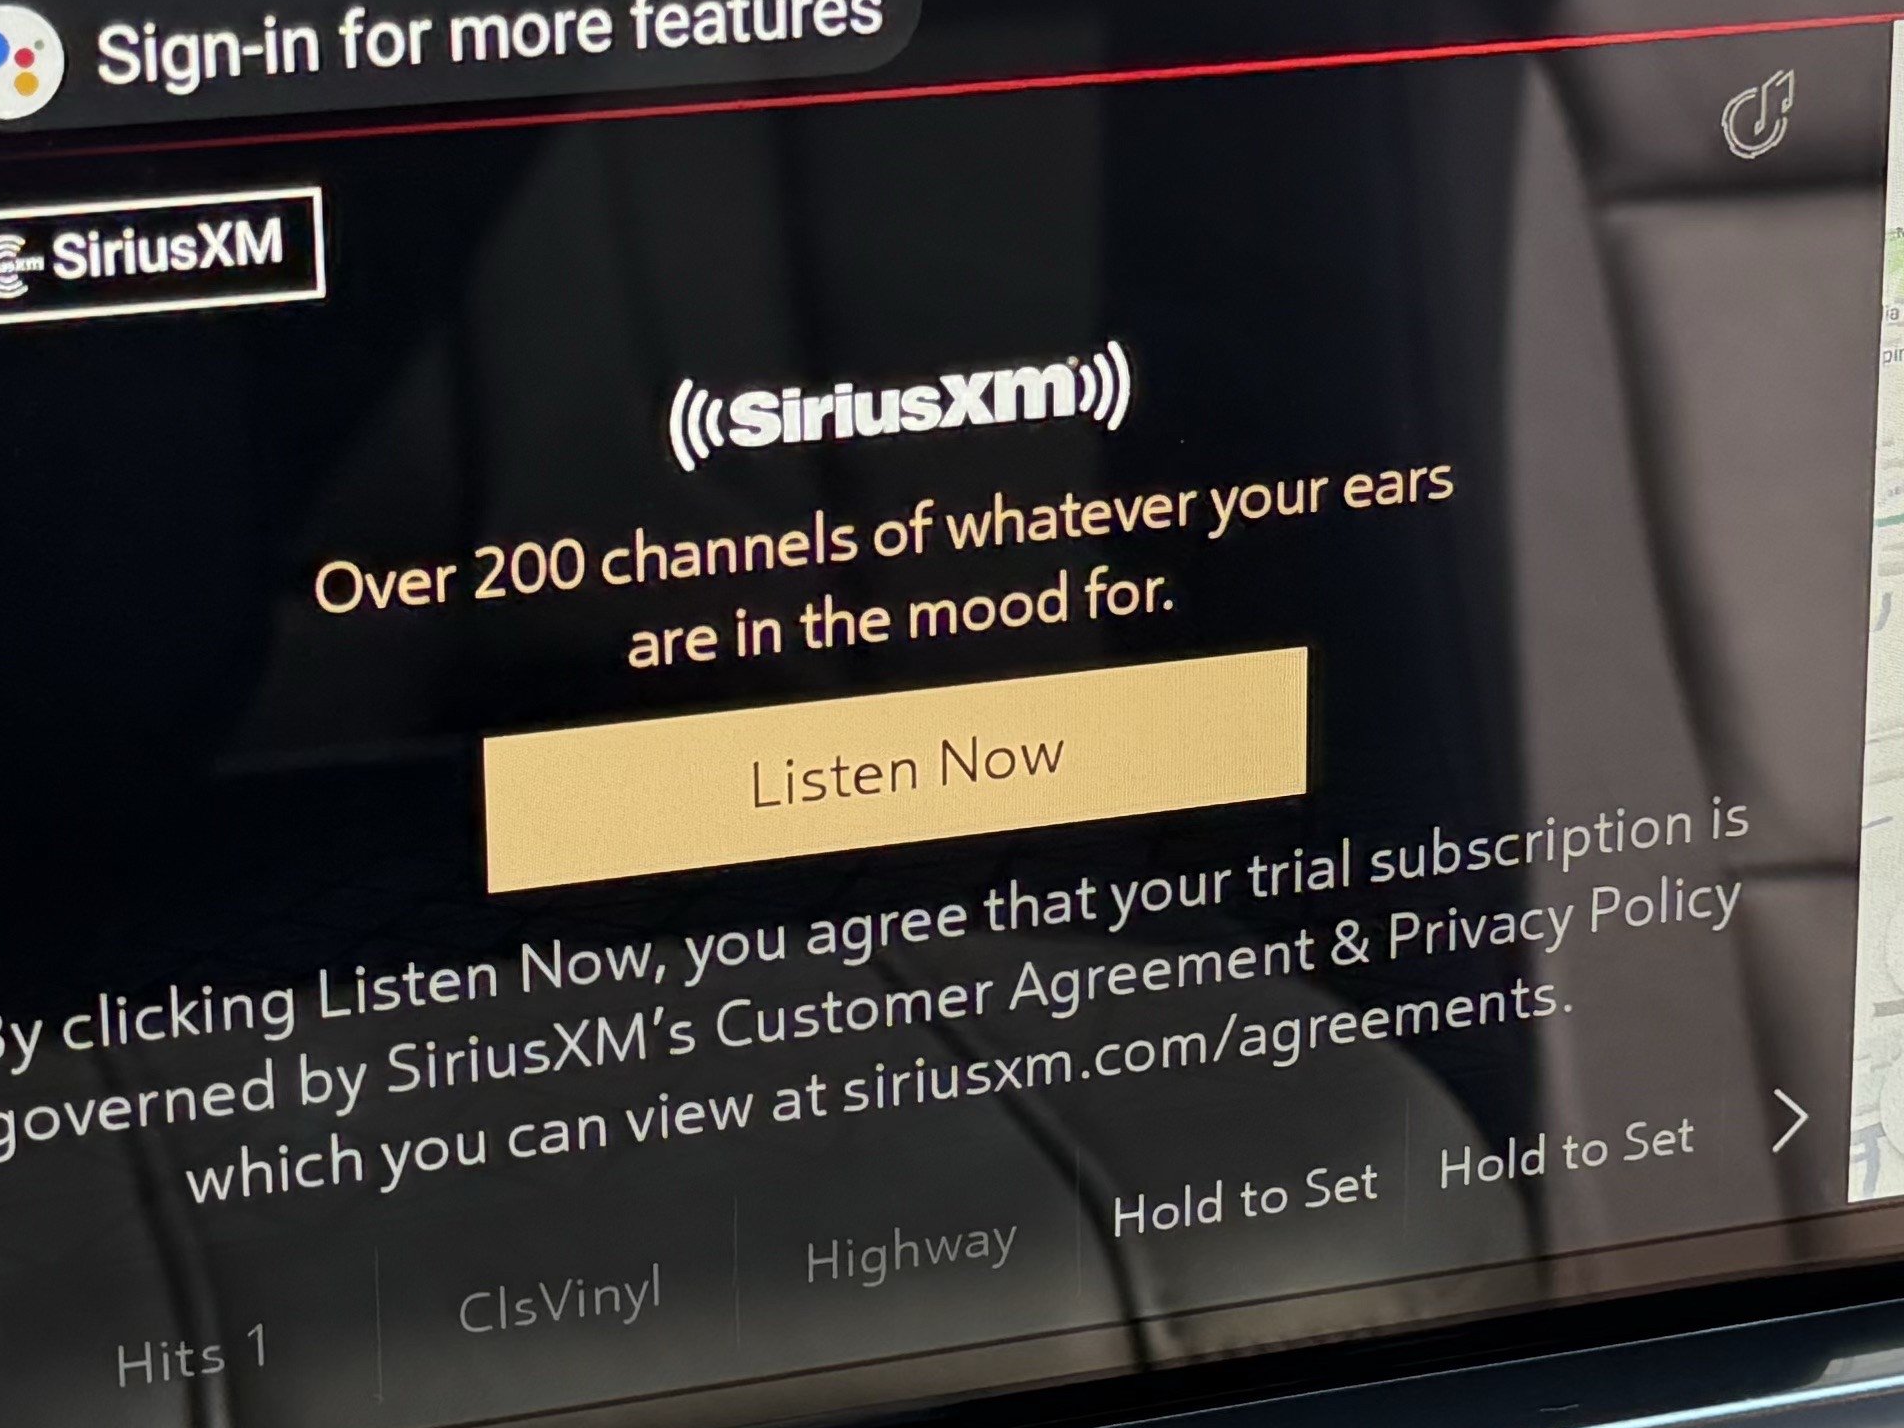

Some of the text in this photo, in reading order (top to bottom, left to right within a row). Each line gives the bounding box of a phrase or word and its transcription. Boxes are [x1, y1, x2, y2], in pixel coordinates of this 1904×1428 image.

[97, 14, 320, 96] Sign-in
[339, 6, 433, 69] for
[450, 5, 613, 63] more
[52, 216, 284, 280] SiriusXM
[314, 463, 1455, 614] Over 200 channels of whatever your ears
[627, 564, 1175, 670] are in the mood for.
[752, 734, 1067, 810] Listen Now
[61, 984, 296, 1043] clicking
[319, 960, 499, 1019] Listen
[520, 938, 667, 994] Now,
[683, 925, 788, 987] you
[806, 901, 968, 967] agree
[983, 876, 1098, 933] that
[1107, 867, 1233, 933] your
[1246, 836, 1353, 899] trial
[1368, 807, 1693, 884] subscription
[1710, 795, 1751, 841] is
[299, 1052, 368, 1118] by
[716, 978, 995, 1049] Customer
[1008, 927, 1316, 1020] Agreement
[1329, 918, 1371, 968] &
[1389, 901, 1576, 961] Privacy
[1589, 874, 1744, 933] Policy
[185, 978, 1576, 1204] which you can view at siriusxm.com/agreements.
[1440, 1117, 1696, 1190] Hold to Set
[1113, 1163, 1379, 1238] Hold to Set
[806, 1224, 1019, 1289] Highway
[458, 1262, 663, 1336] ClsVinyl
[116, 1322, 268, 1389] Hits 1
